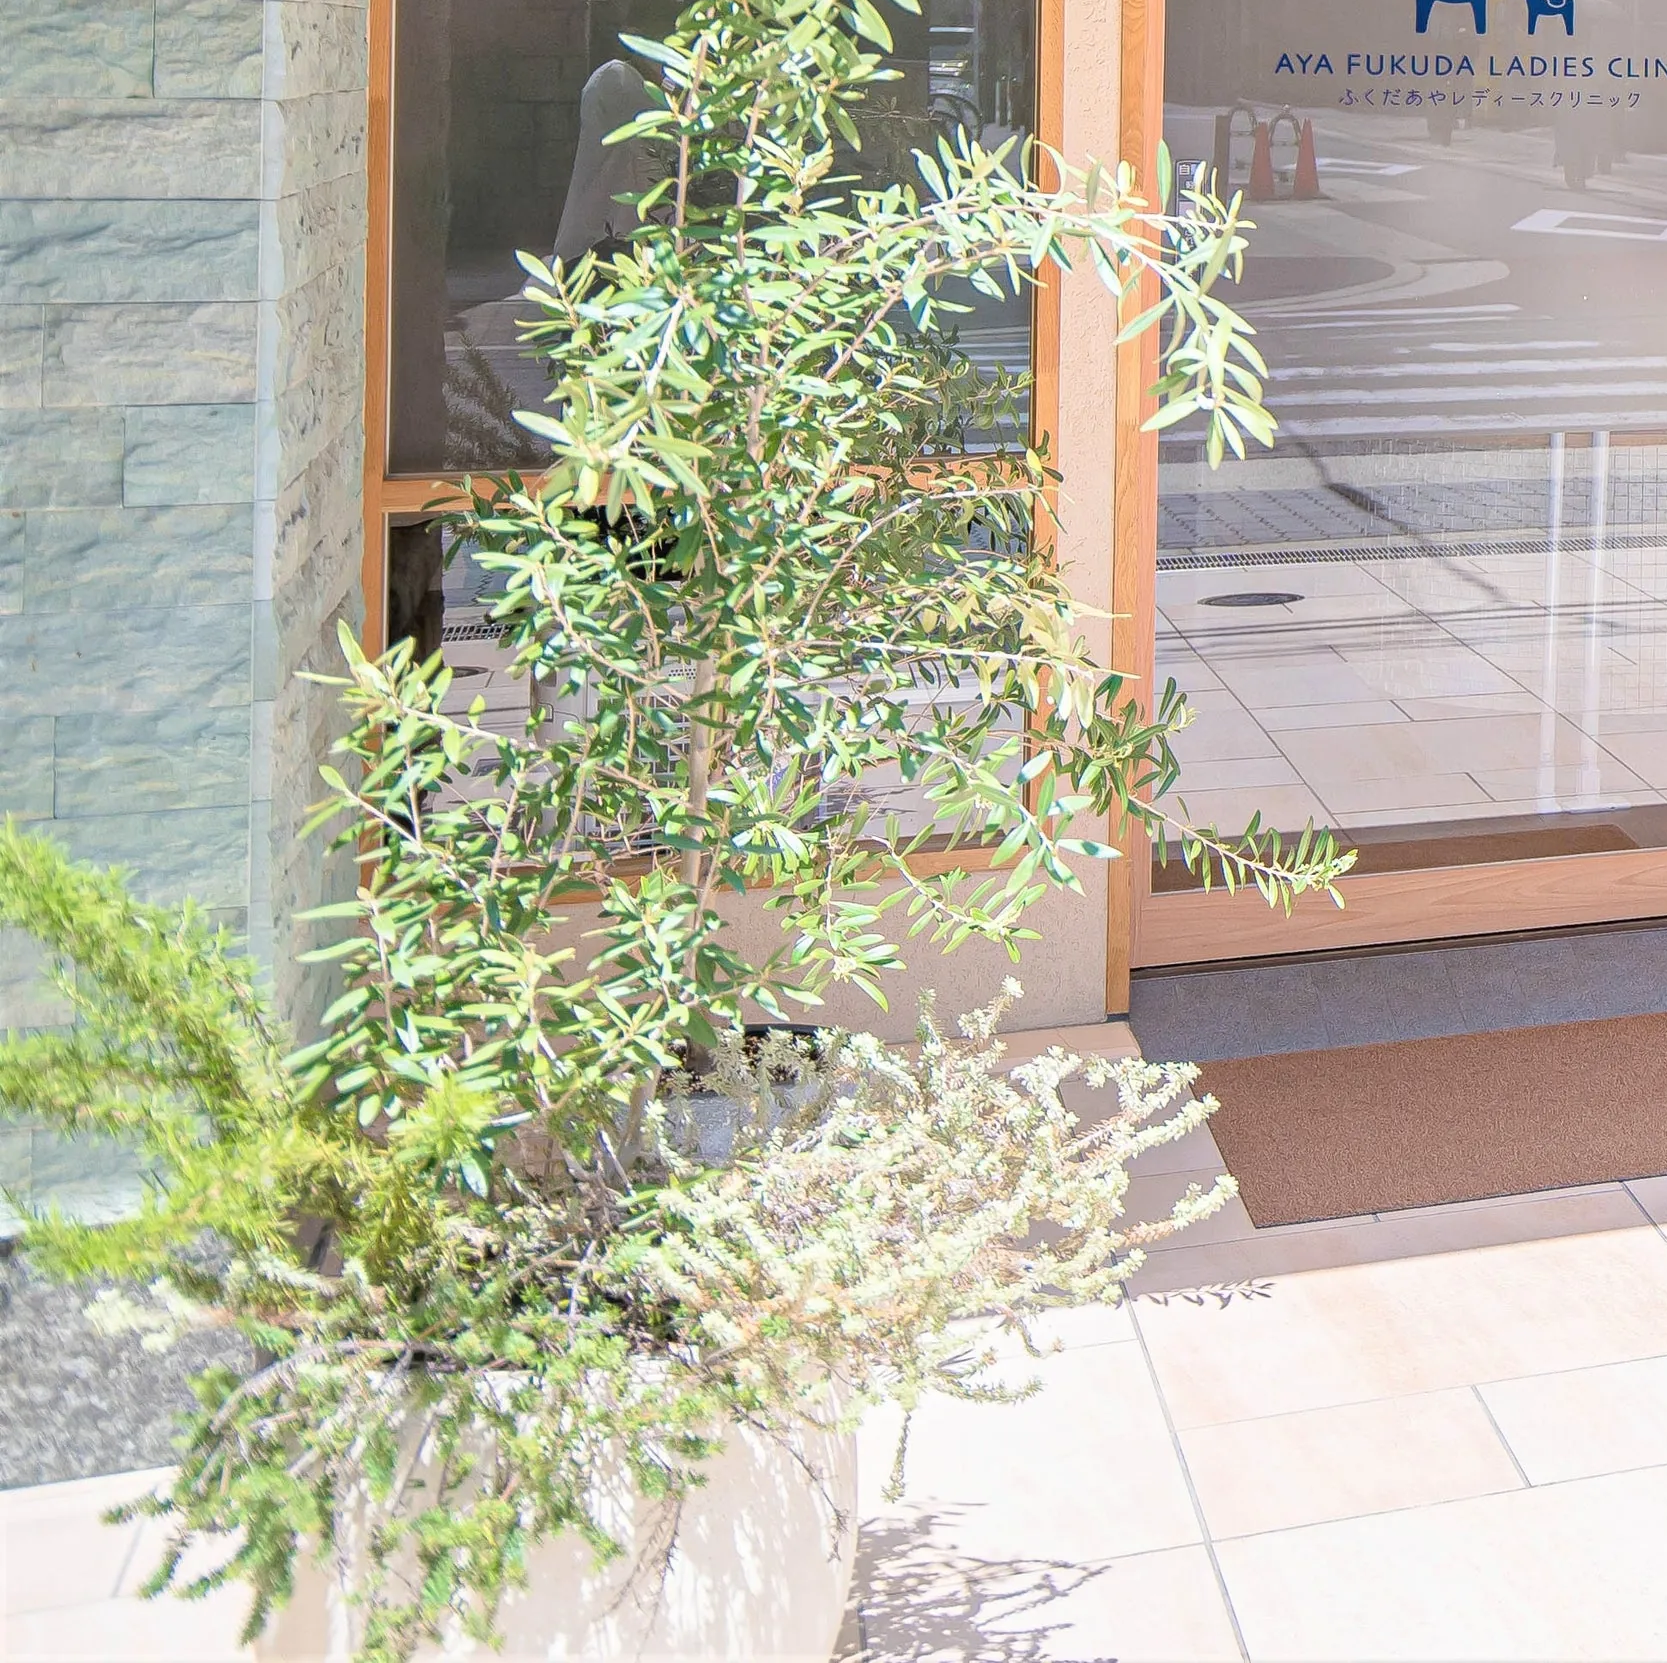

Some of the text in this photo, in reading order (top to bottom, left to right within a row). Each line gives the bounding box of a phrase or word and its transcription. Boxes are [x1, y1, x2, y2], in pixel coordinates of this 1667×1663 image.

[1274, 52, 1335, 76] AYA
[1347, 53, 1475, 77] FUKUDA
[1489, 55, 1594, 79] LADIES
[1338, 87, 1641, 108] ふくだあやレディースクリニック
